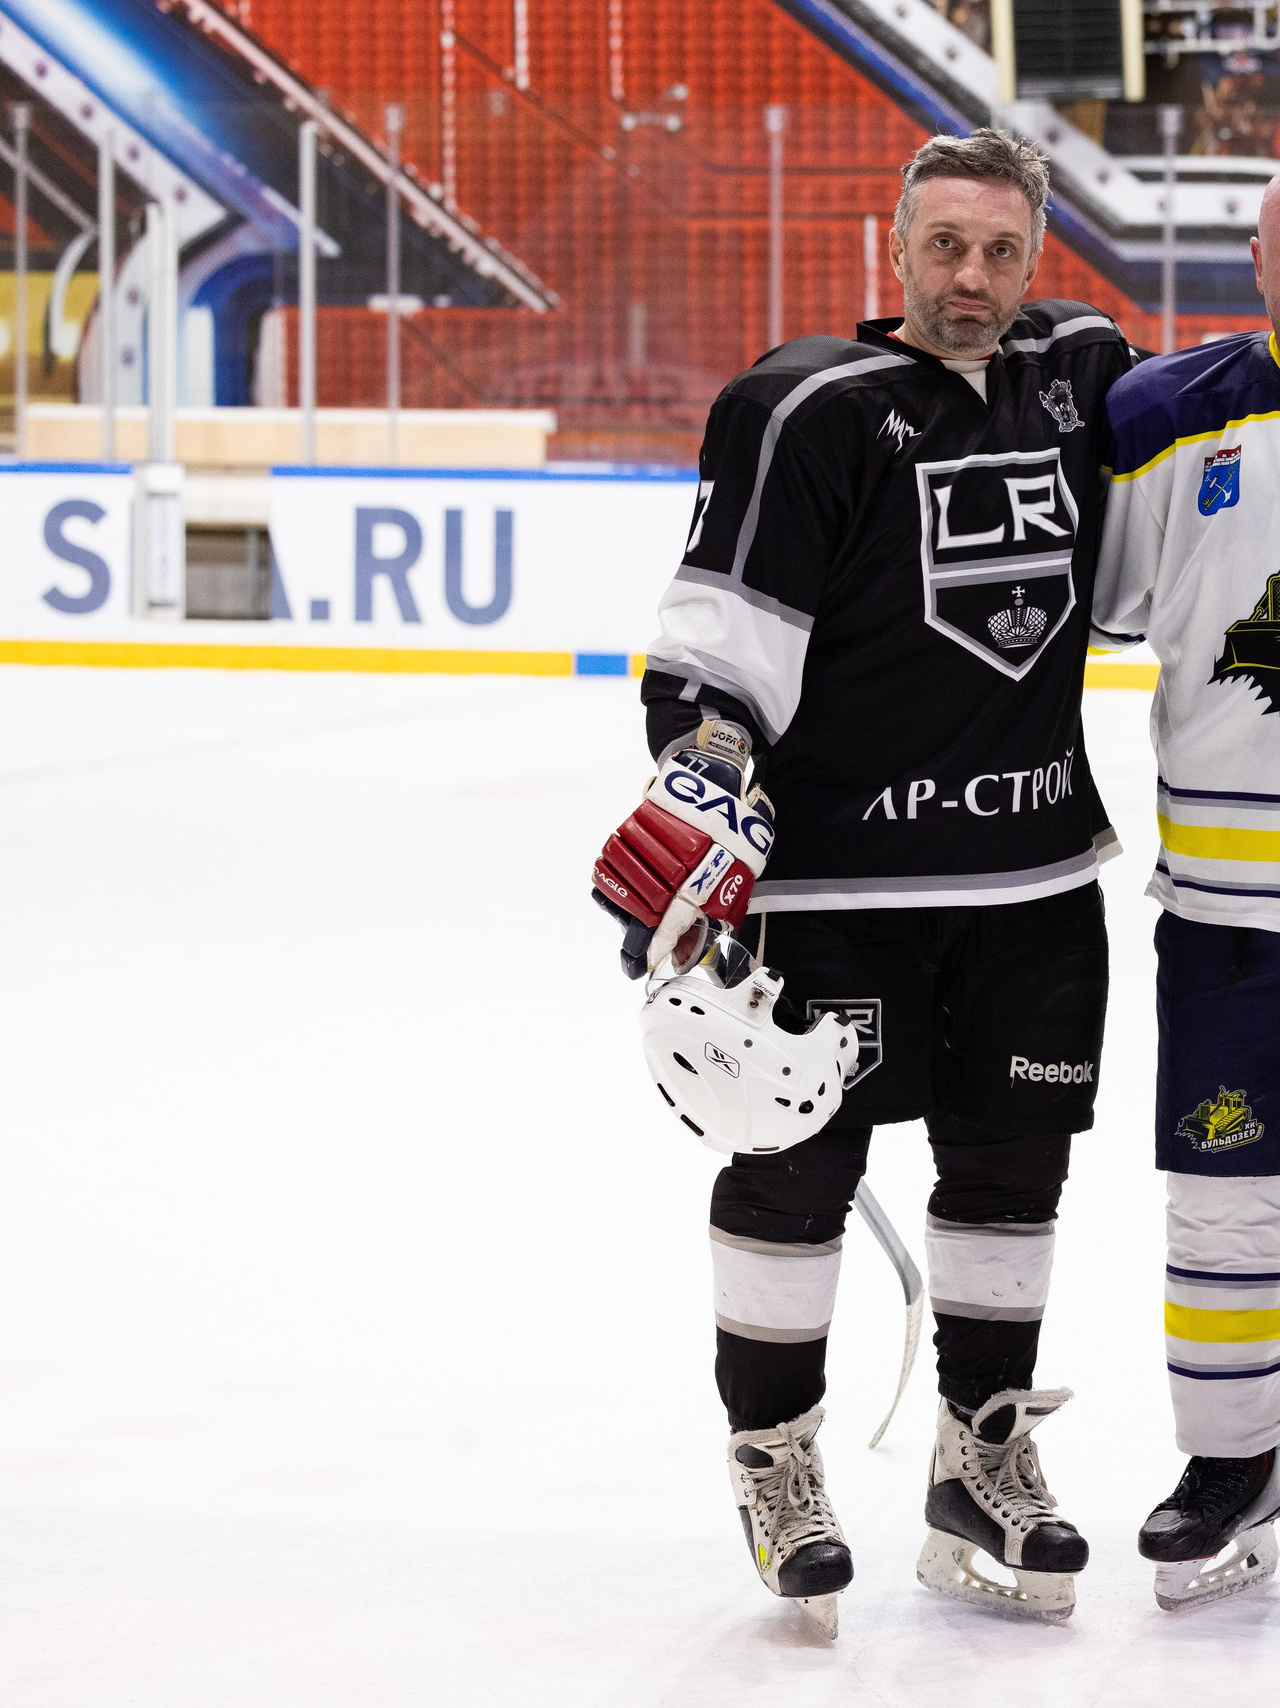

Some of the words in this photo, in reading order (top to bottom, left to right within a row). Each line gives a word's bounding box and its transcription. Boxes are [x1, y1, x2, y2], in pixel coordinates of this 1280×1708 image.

[933, 473, 1073, 551] LR
[861, 747, 1075, 821] ЛР-СТРОЙ
[1009, 1055, 1094, 1085] Reebok
[1201, 1128, 1256, 1149] БУЛЬДОЗЕР
